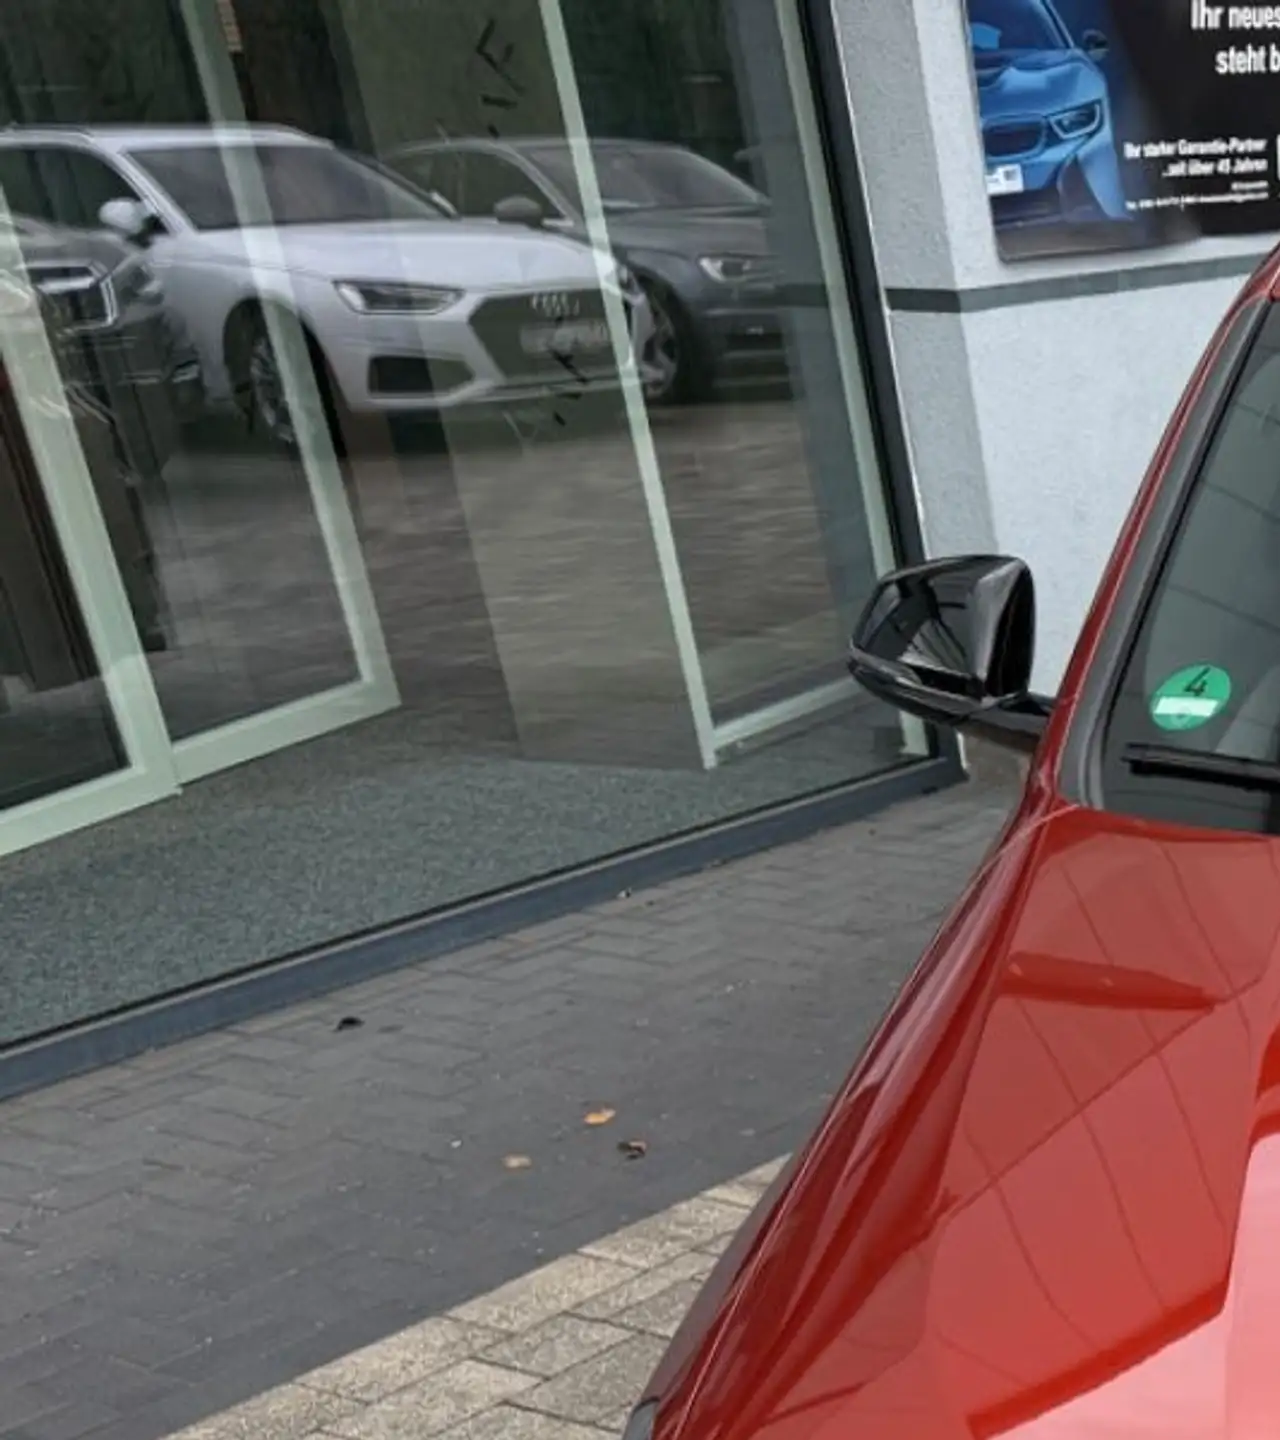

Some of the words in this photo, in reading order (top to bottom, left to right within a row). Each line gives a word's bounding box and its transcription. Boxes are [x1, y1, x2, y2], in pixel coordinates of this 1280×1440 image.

[1191, 0, 1223, 29] Ihr
[1215, 44, 1266, 74] steht
[1184, 667, 1211, 697] 4
